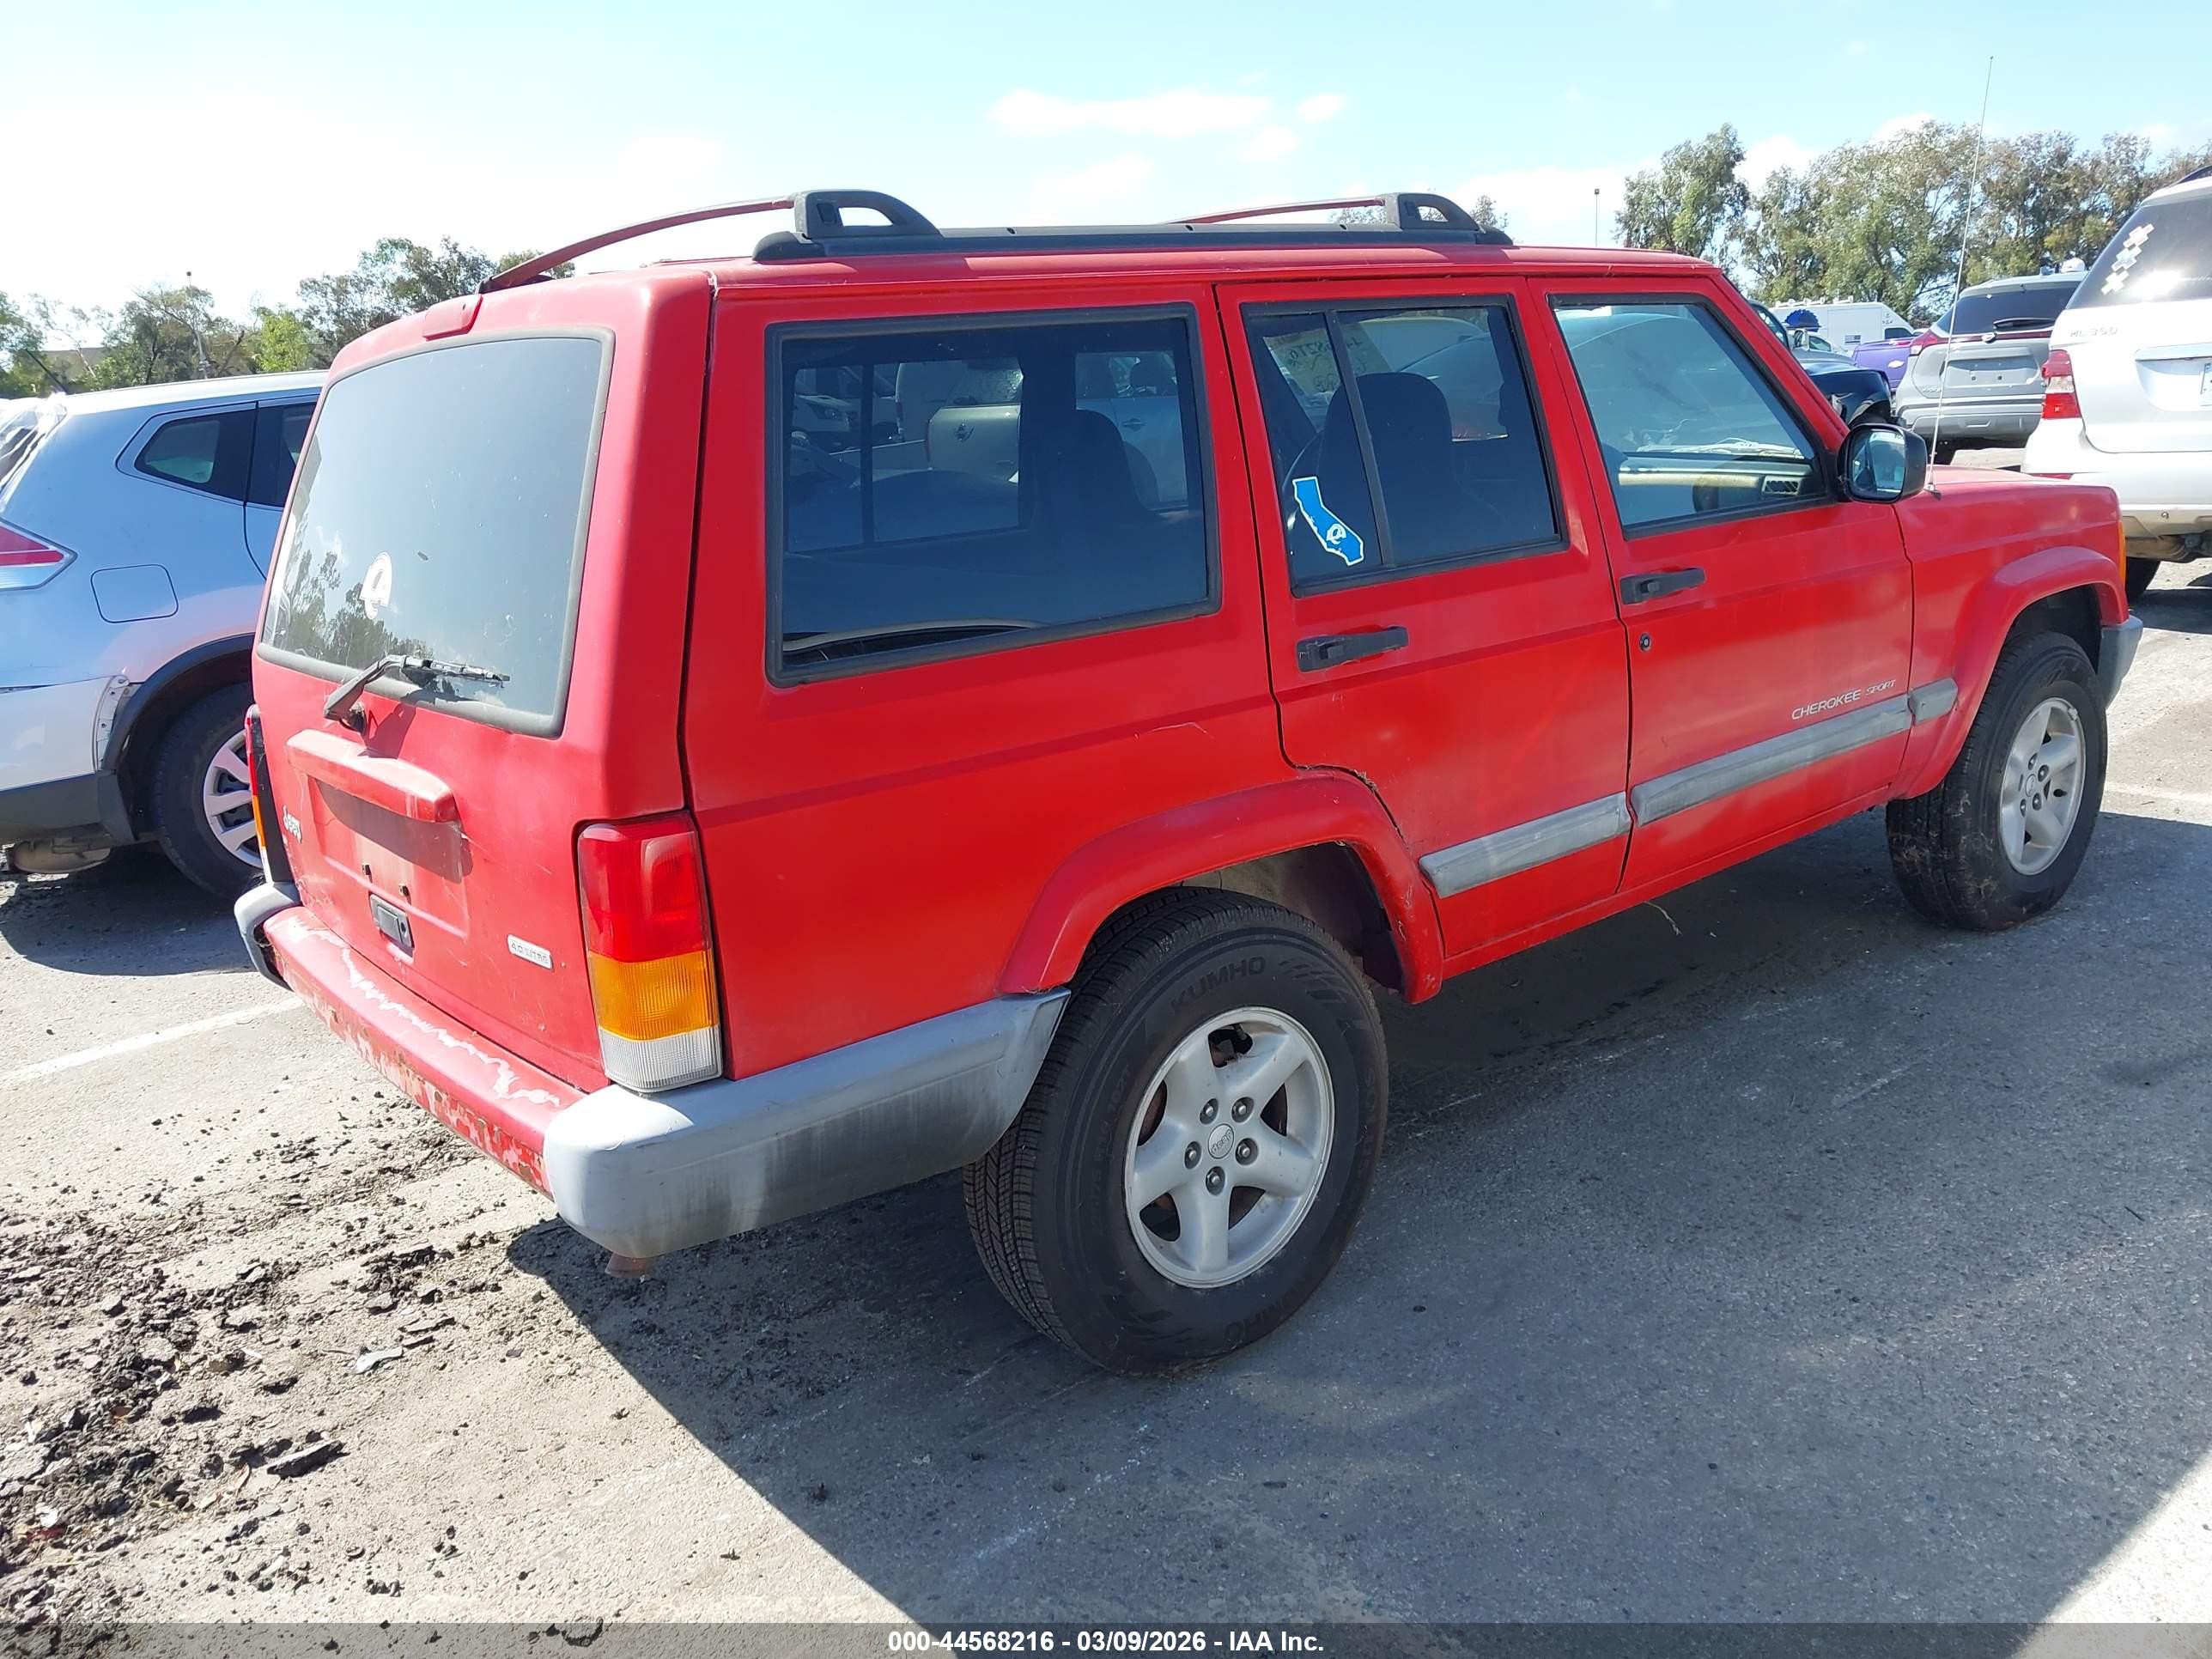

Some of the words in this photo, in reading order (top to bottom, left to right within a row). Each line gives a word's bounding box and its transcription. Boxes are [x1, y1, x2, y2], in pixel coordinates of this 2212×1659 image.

[1791, 689, 1862, 720] CHEROKEE
[1865, 679, 1896, 696] SPORT
[283, 805, 302, 844] Jeep
[525, 948, 549, 963] LITRE
[1169, 956, 1267, 1017] KUMHO
